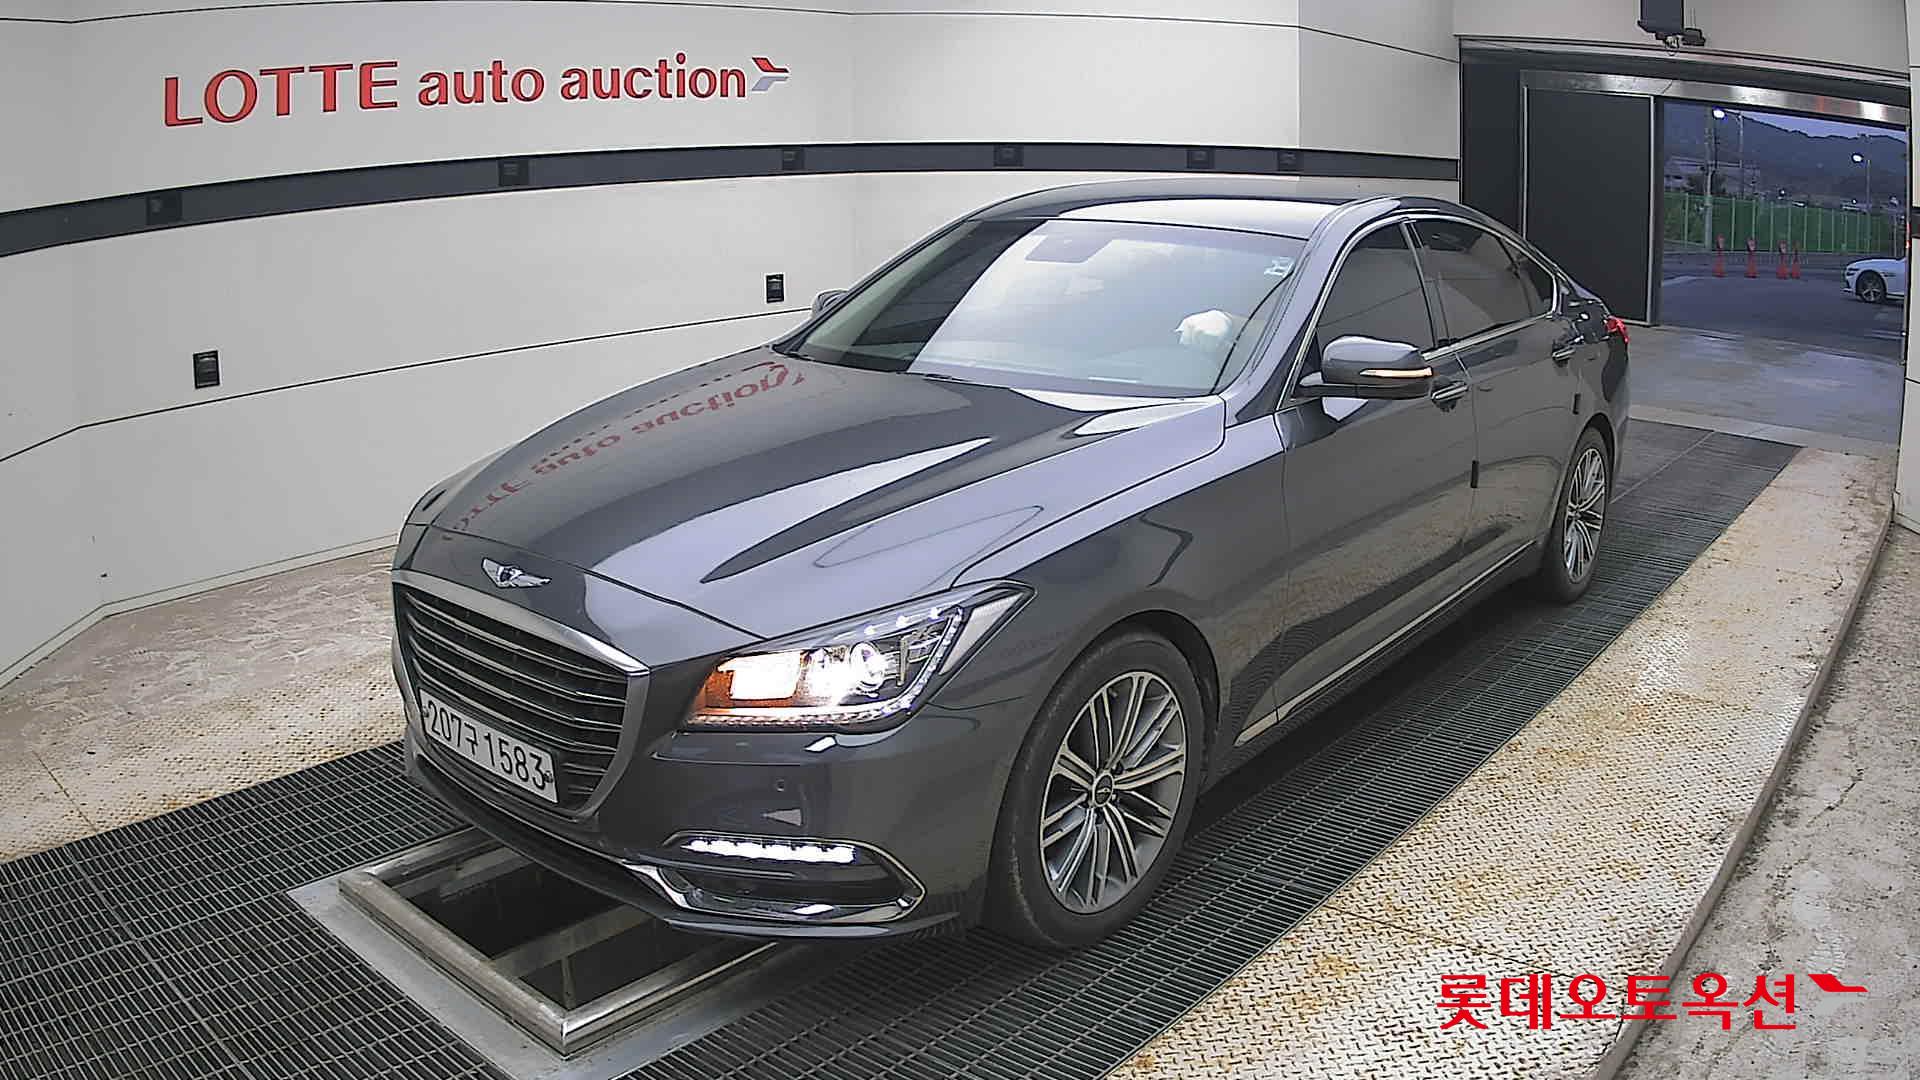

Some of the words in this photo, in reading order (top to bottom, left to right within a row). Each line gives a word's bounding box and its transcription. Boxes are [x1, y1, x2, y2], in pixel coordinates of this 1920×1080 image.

[164, 61, 398, 127] LOTTE
[418, 59, 545, 106] auto
[560, 52, 746, 100] auction
[483, 731, 546, 790] 1583
